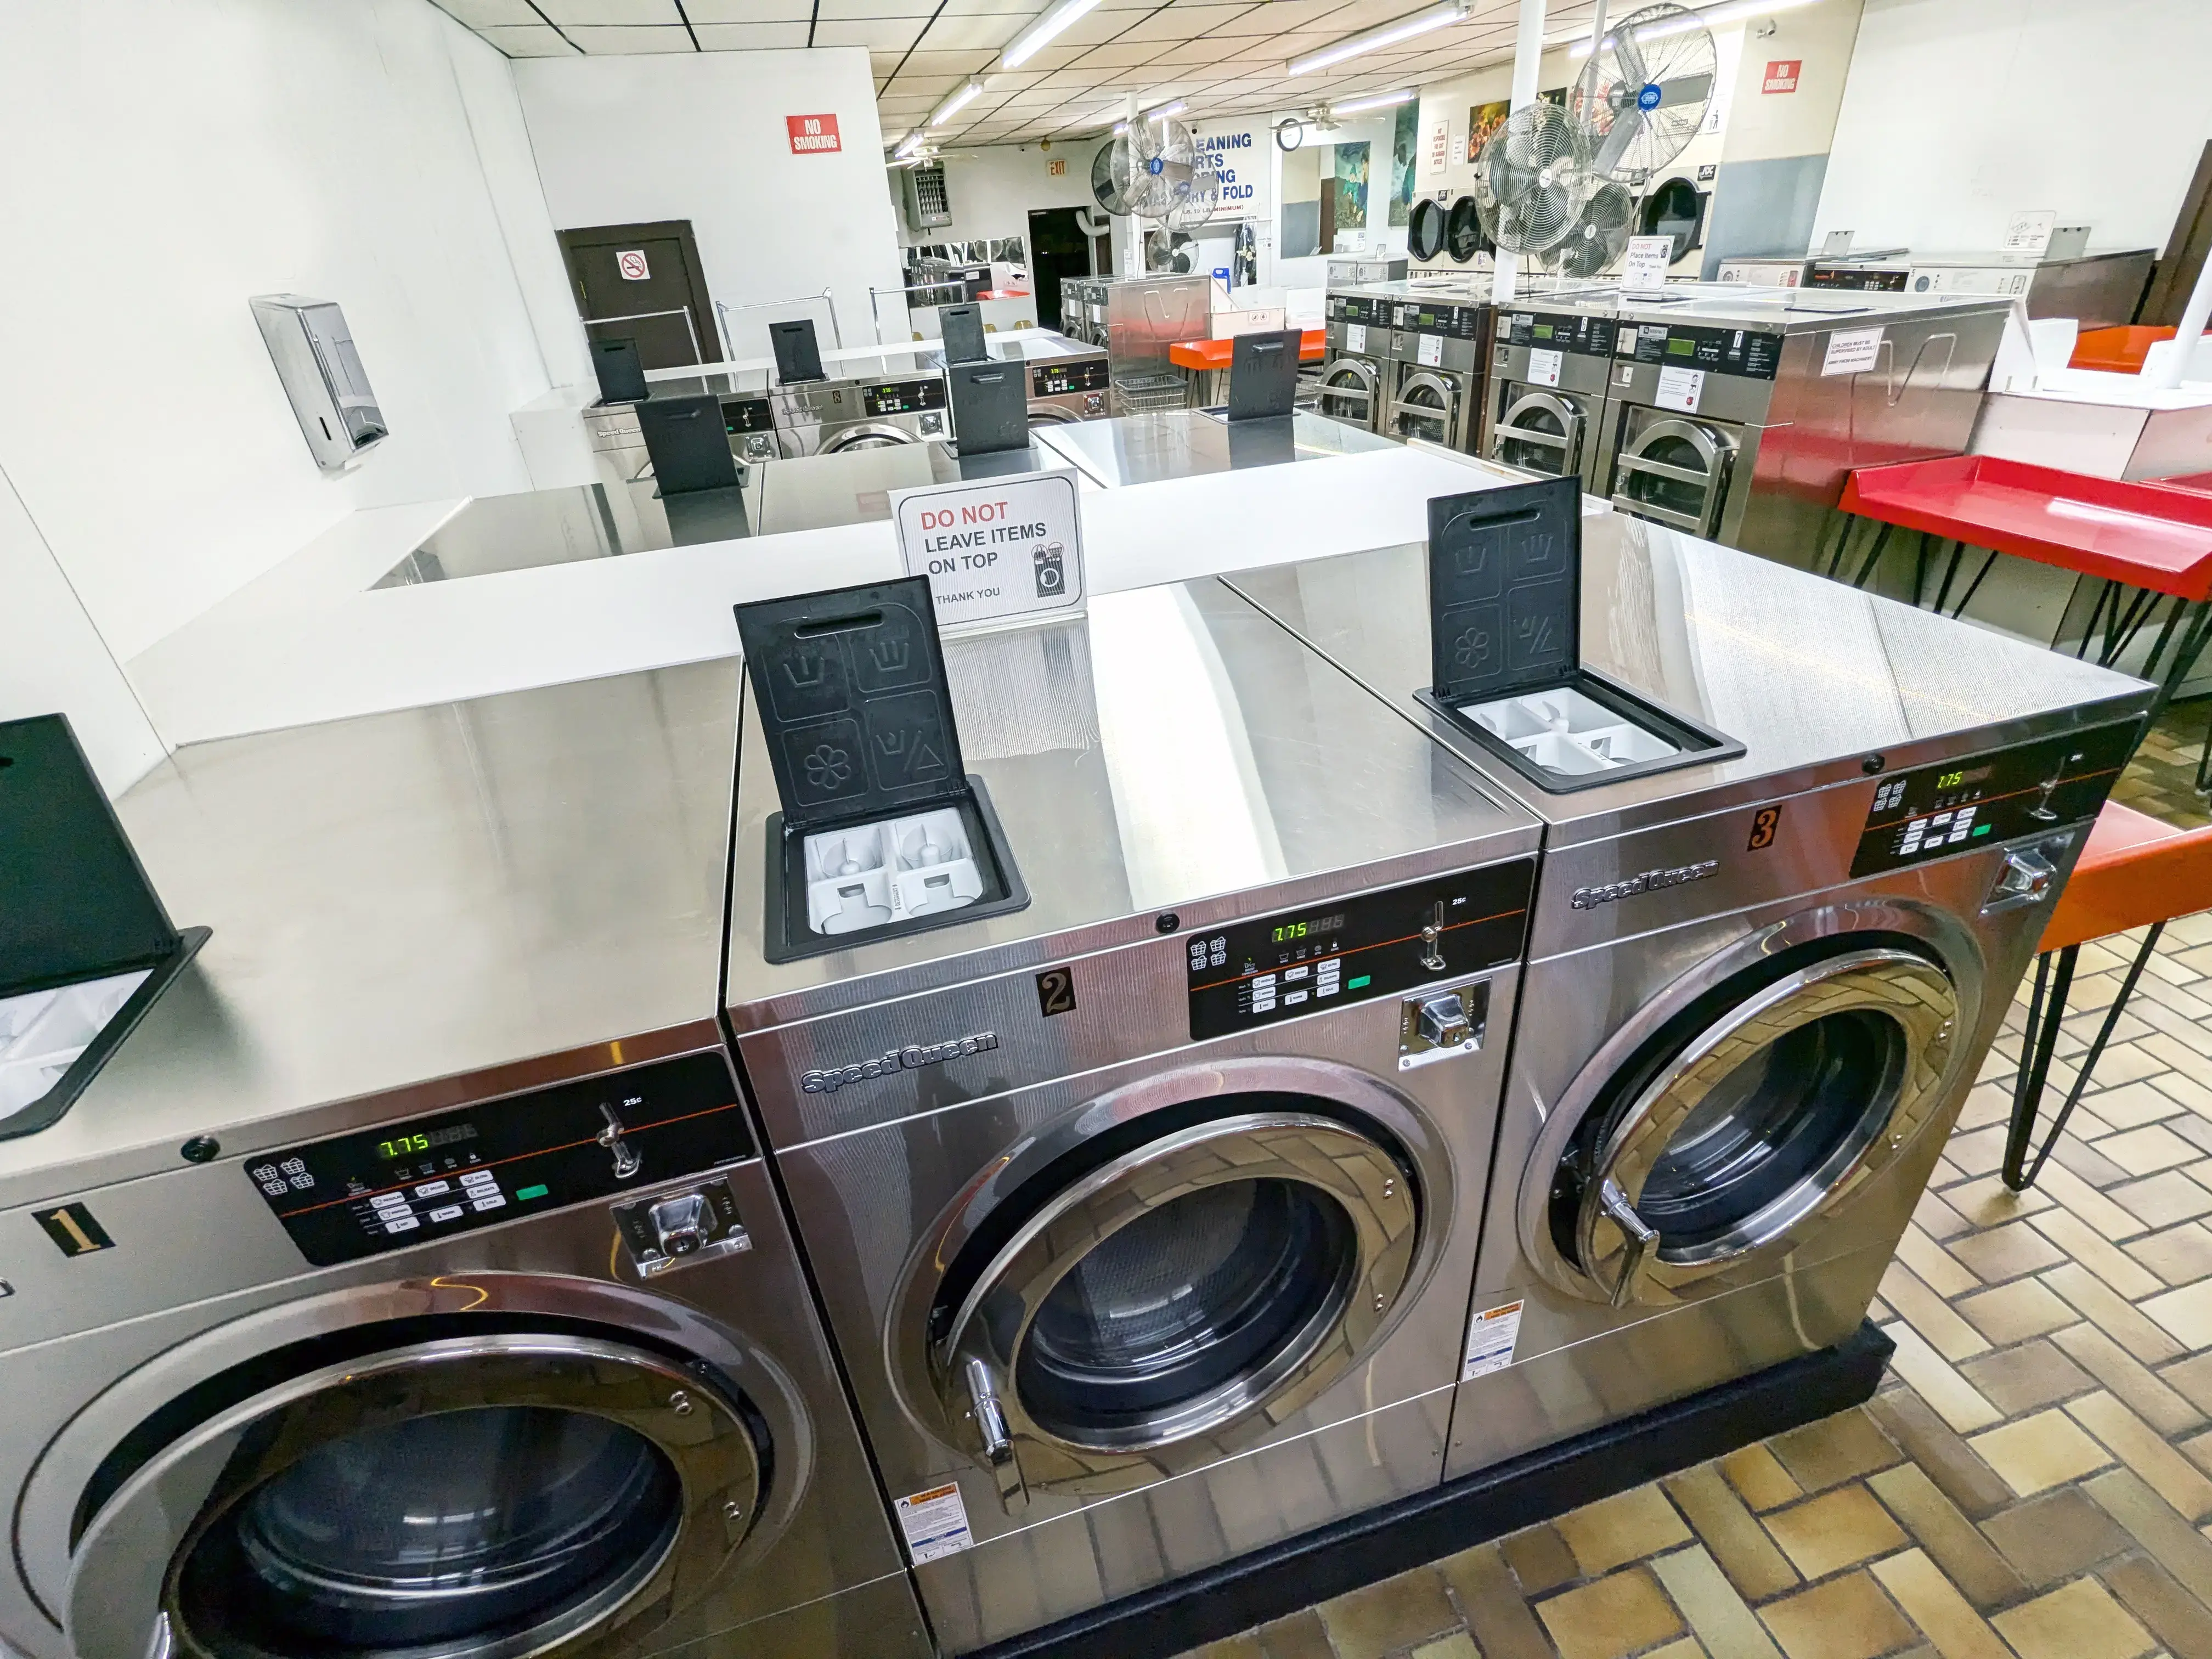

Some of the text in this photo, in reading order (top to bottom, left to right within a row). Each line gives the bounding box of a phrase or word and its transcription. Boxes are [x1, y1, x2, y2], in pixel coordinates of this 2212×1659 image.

[1777, 64, 1789, 78] NO
[1764, 78, 1796, 91] SMOKING
[804, 119, 821, 135] NO
[793, 134, 838, 150] SMOKING
[1196, 133, 1251, 153] EANING
[1050, 161, 1065, 175] EXIT
[1223, 184, 1253, 200] FOLD
[1733, 332, 1742, 347] 7
[834, 392, 840, 403] 8
[921, 501, 1008, 530] DO NOT
[925, 522, 1046, 552] LEAVE ITEMS
[928, 552, 998, 575] ON TOP
[936, 587, 1000, 605] THANK YOU
[1752, 810, 1776, 848] 3
[1275, 923, 1306, 941] 7.75
[1042, 973, 1070, 1014] 2
[801, 1031, 998, 1093] Speed Queen
[380, 1134, 428, 1156] 7.75
[50, 1209, 101, 1252] 1
